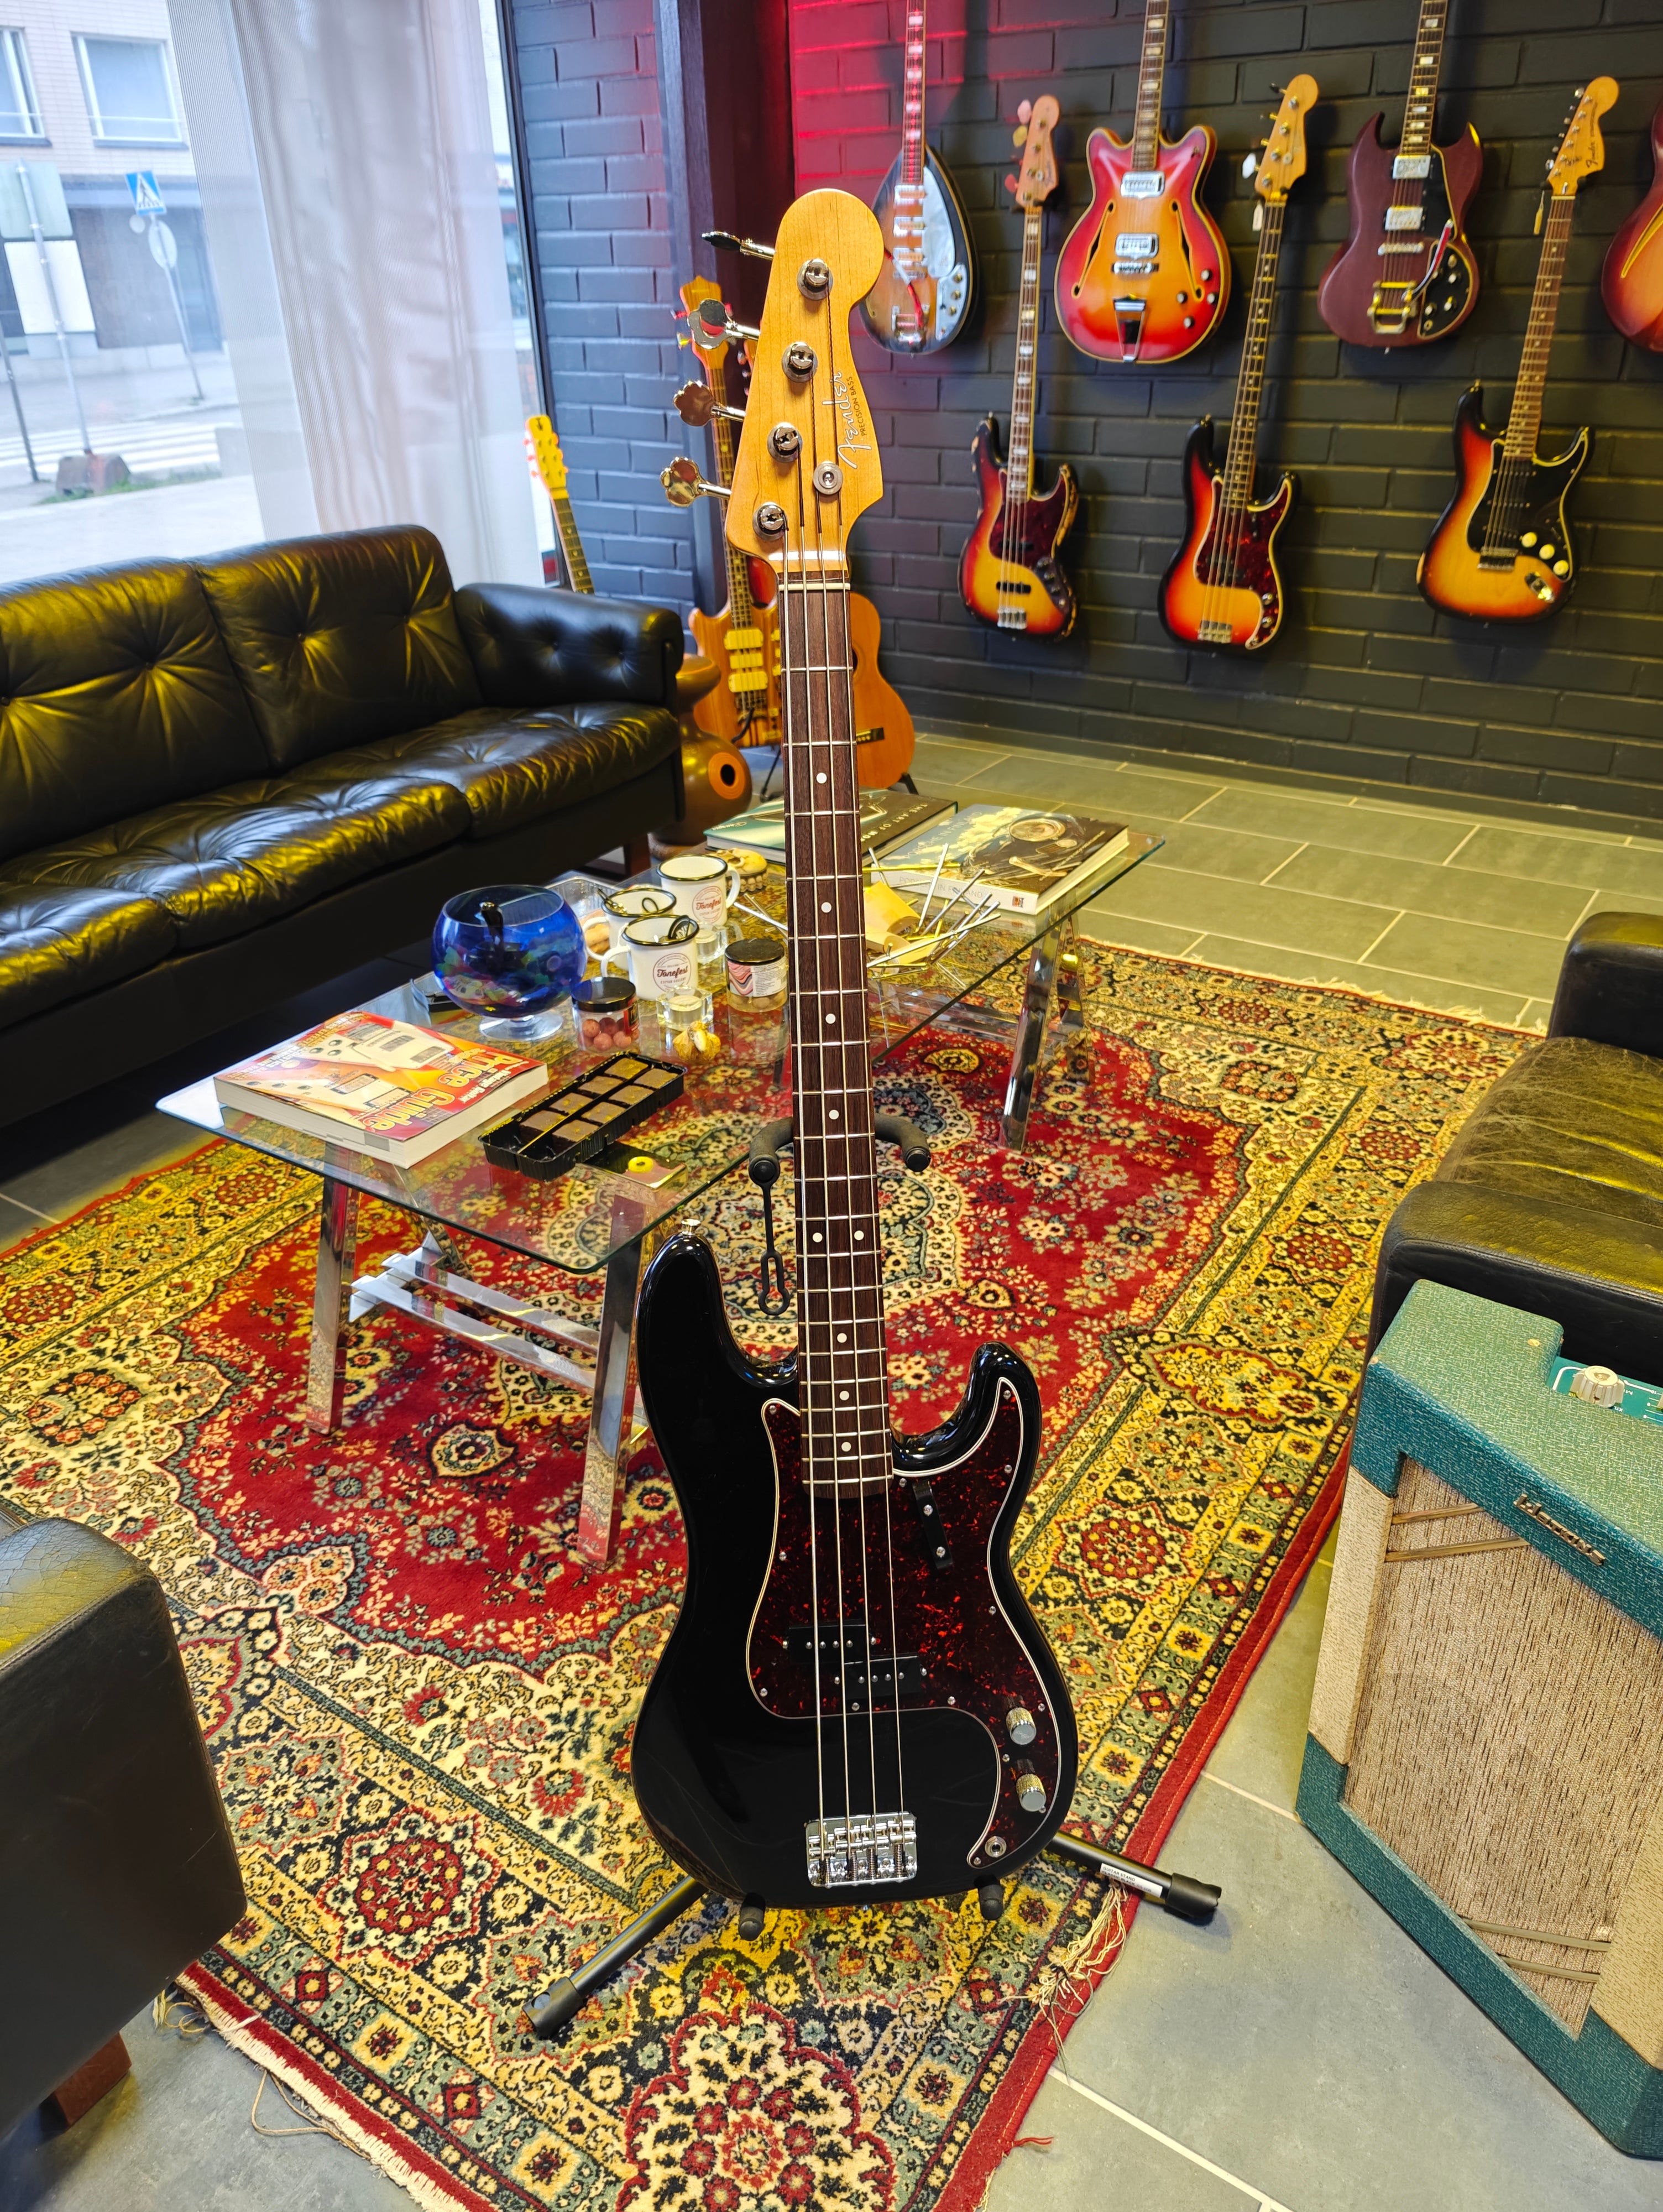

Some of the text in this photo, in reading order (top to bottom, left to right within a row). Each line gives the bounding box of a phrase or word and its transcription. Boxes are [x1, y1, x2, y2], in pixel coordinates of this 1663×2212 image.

[822, 372, 872, 468] Fender
[846, 377, 867, 436] PRECISION BASS
[657, 966, 688, 978] Tonefest
[438, 1051, 523, 1088] Price
[363, 1087, 456, 1130] Guide
[1103, 1866, 1136, 1882] GUITAR STAND
